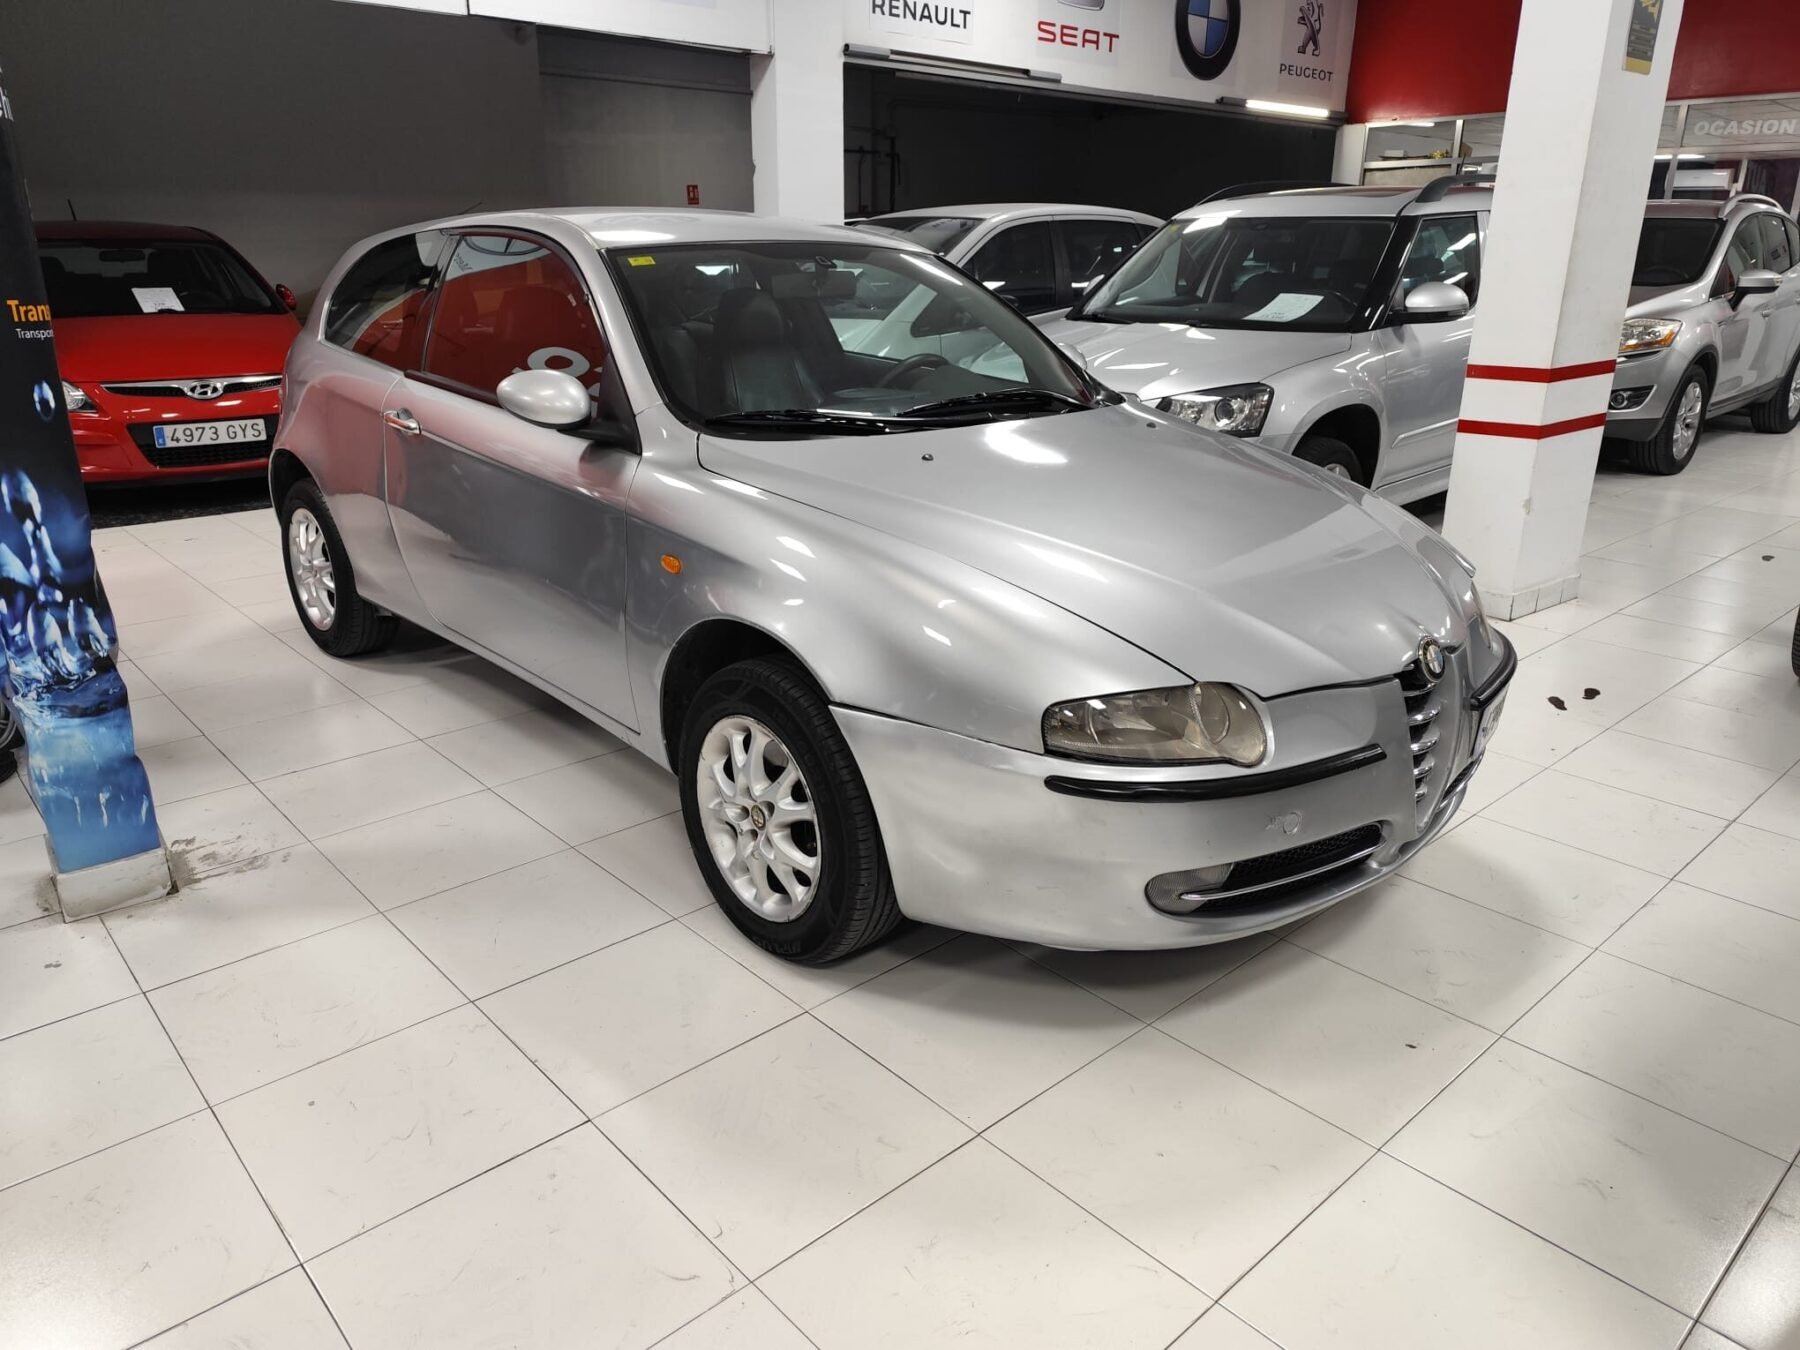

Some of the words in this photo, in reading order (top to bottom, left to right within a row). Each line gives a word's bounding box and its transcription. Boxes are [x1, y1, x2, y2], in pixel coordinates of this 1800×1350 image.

[871, 0, 971, 30] RENAULT
[1037, 20, 1120, 53] SEAT
[1279, 63, 1334, 82] PEUGEOT
[1694, 119, 1797, 136] OCASION
[170, 425, 220, 444] 4973
[226, 422, 262, 440] GYS
